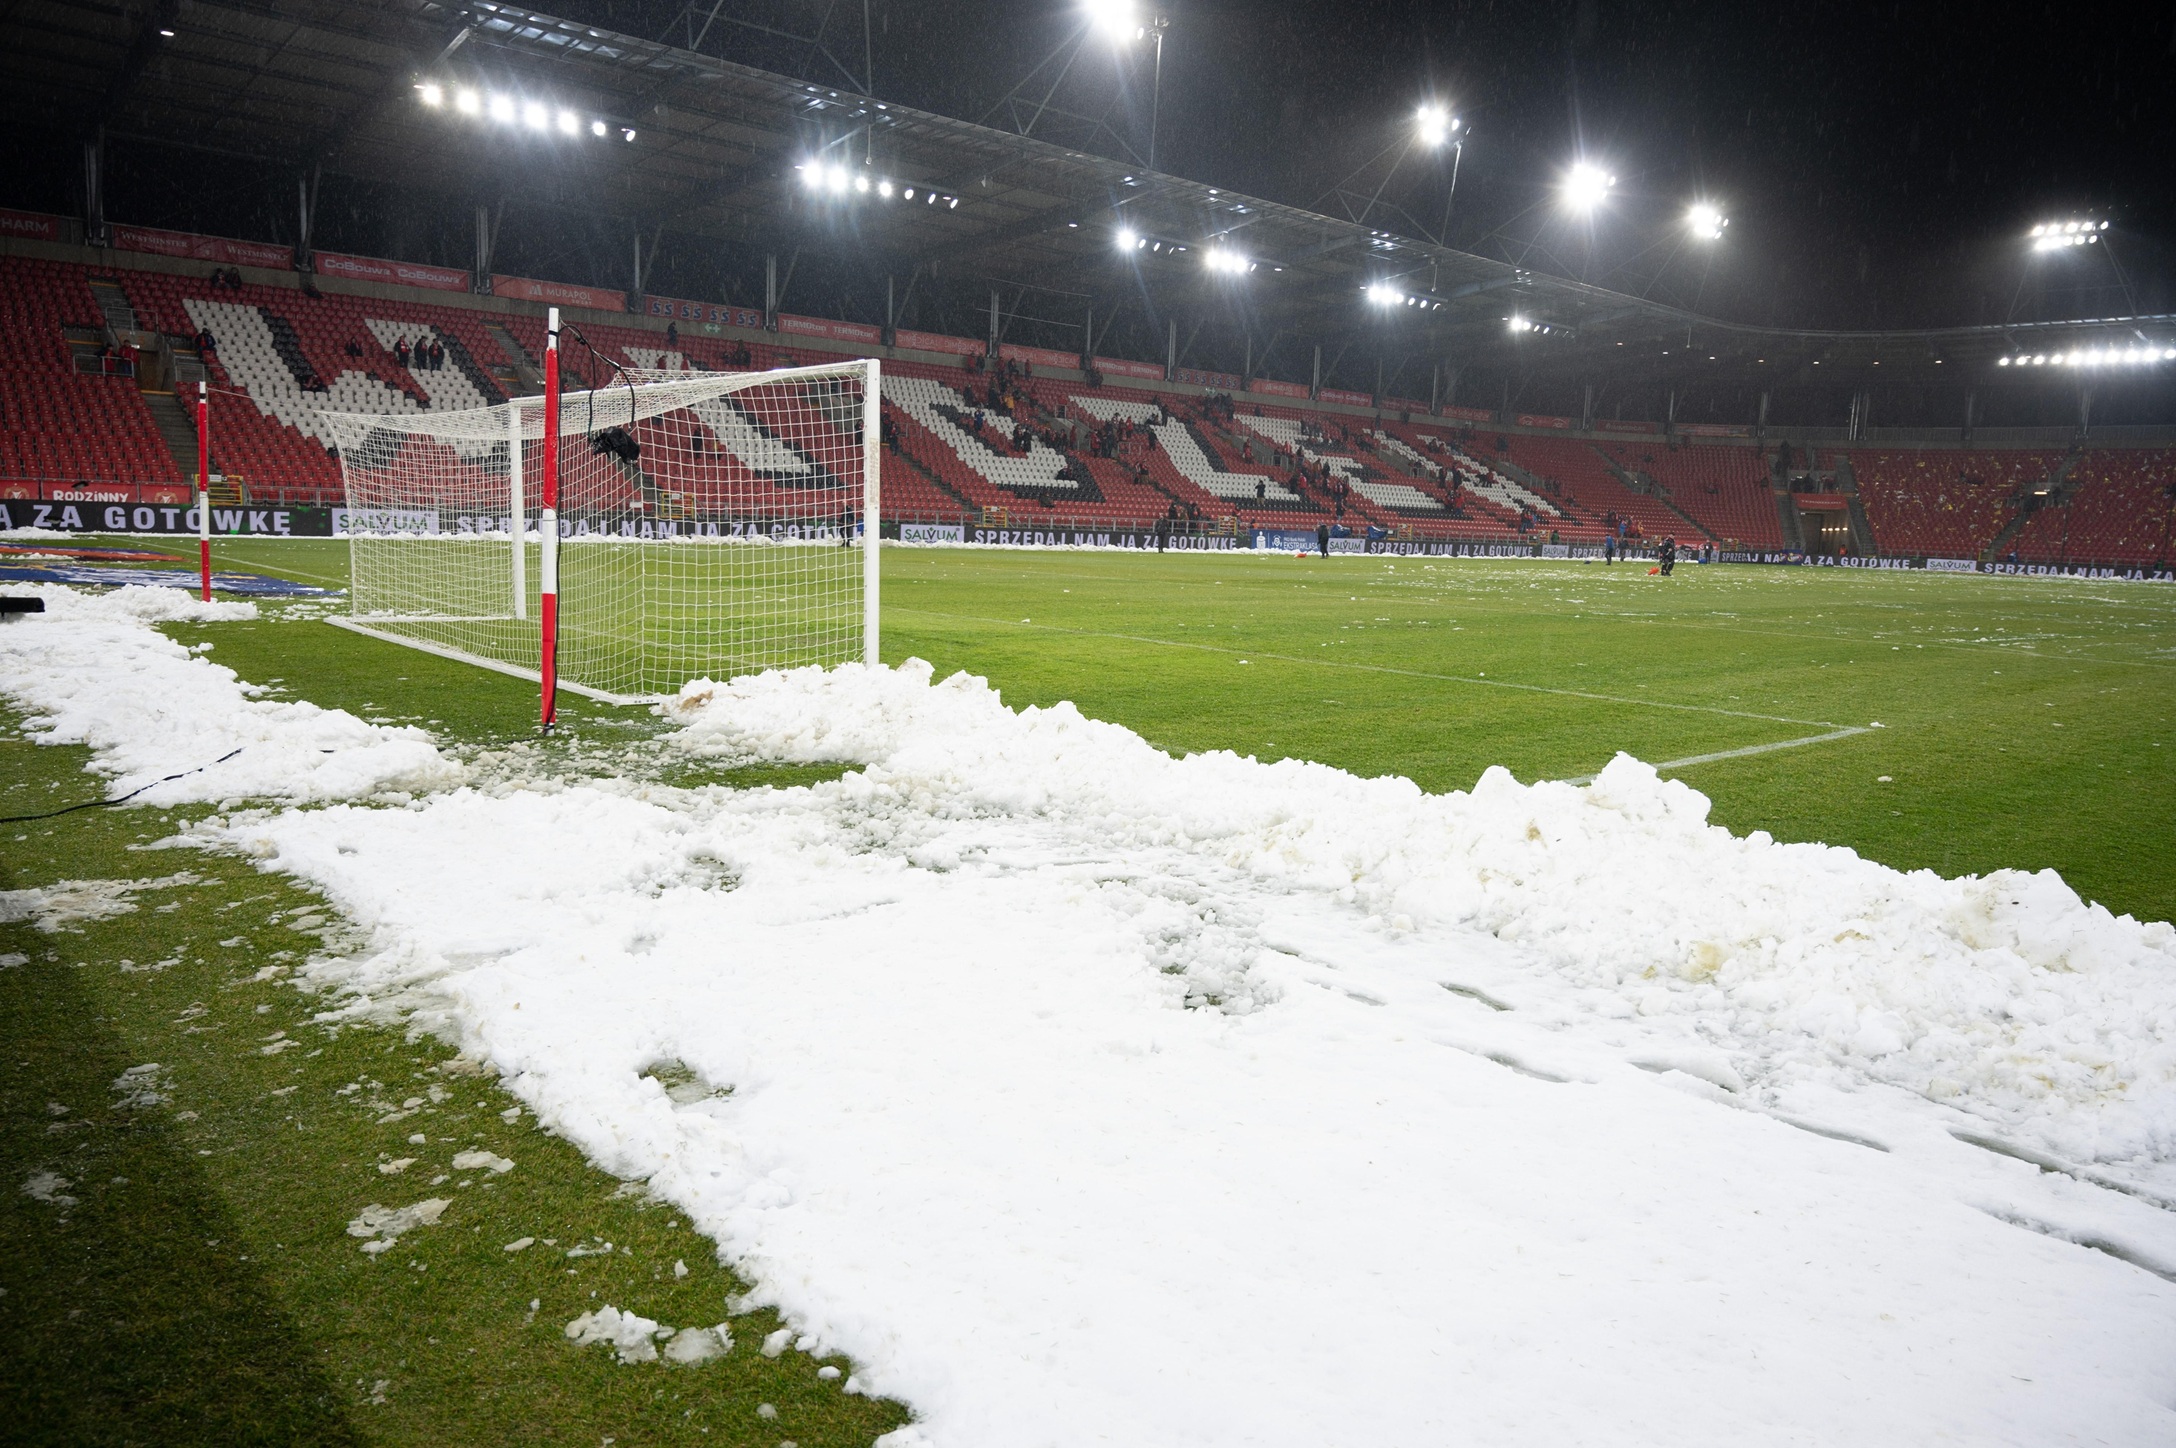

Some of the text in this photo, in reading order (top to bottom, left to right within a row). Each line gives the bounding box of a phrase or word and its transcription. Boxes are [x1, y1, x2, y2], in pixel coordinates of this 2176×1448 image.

[121, 231, 188, 248] WESTMINSTER
[546, 288, 592, 300] MURAPOL
[33, 504, 83, 528] ZA
[104, 503, 290, 536] GOTÓWKĘ
[339, 512, 428, 530] SALVUM
[621, 520, 677, 539] NAM
[732, 523, 758, 541] ZA
[904, 527, 958, 541] SALVUM
[974, 530, 1066, 546] SPRZEDAJ
[1074, 533, 1110, 547] NAM
[1143, 535, 1159, 549] ZA
[1284, 541, 1318, 550] EKSTRAKLASA
[1329, 540, 1361, 551] SALVUM
[1370, 541, 1426, 554] SPRZEDAJ
[1430, 544, 1453, 555] NAM
[1473, 545, 1485, 556] ZA
[1543, 547, 1566, 555] SALVUM
[1817, 556, 1834, 566] ZA
[1929, 560, 1971, 569] SALVUM
[1984, 562, 2069, 576] SPRZEDAJ
[2077, 567, 2115, 578] NAM
[2152, 571, 2174, 582] ZA
